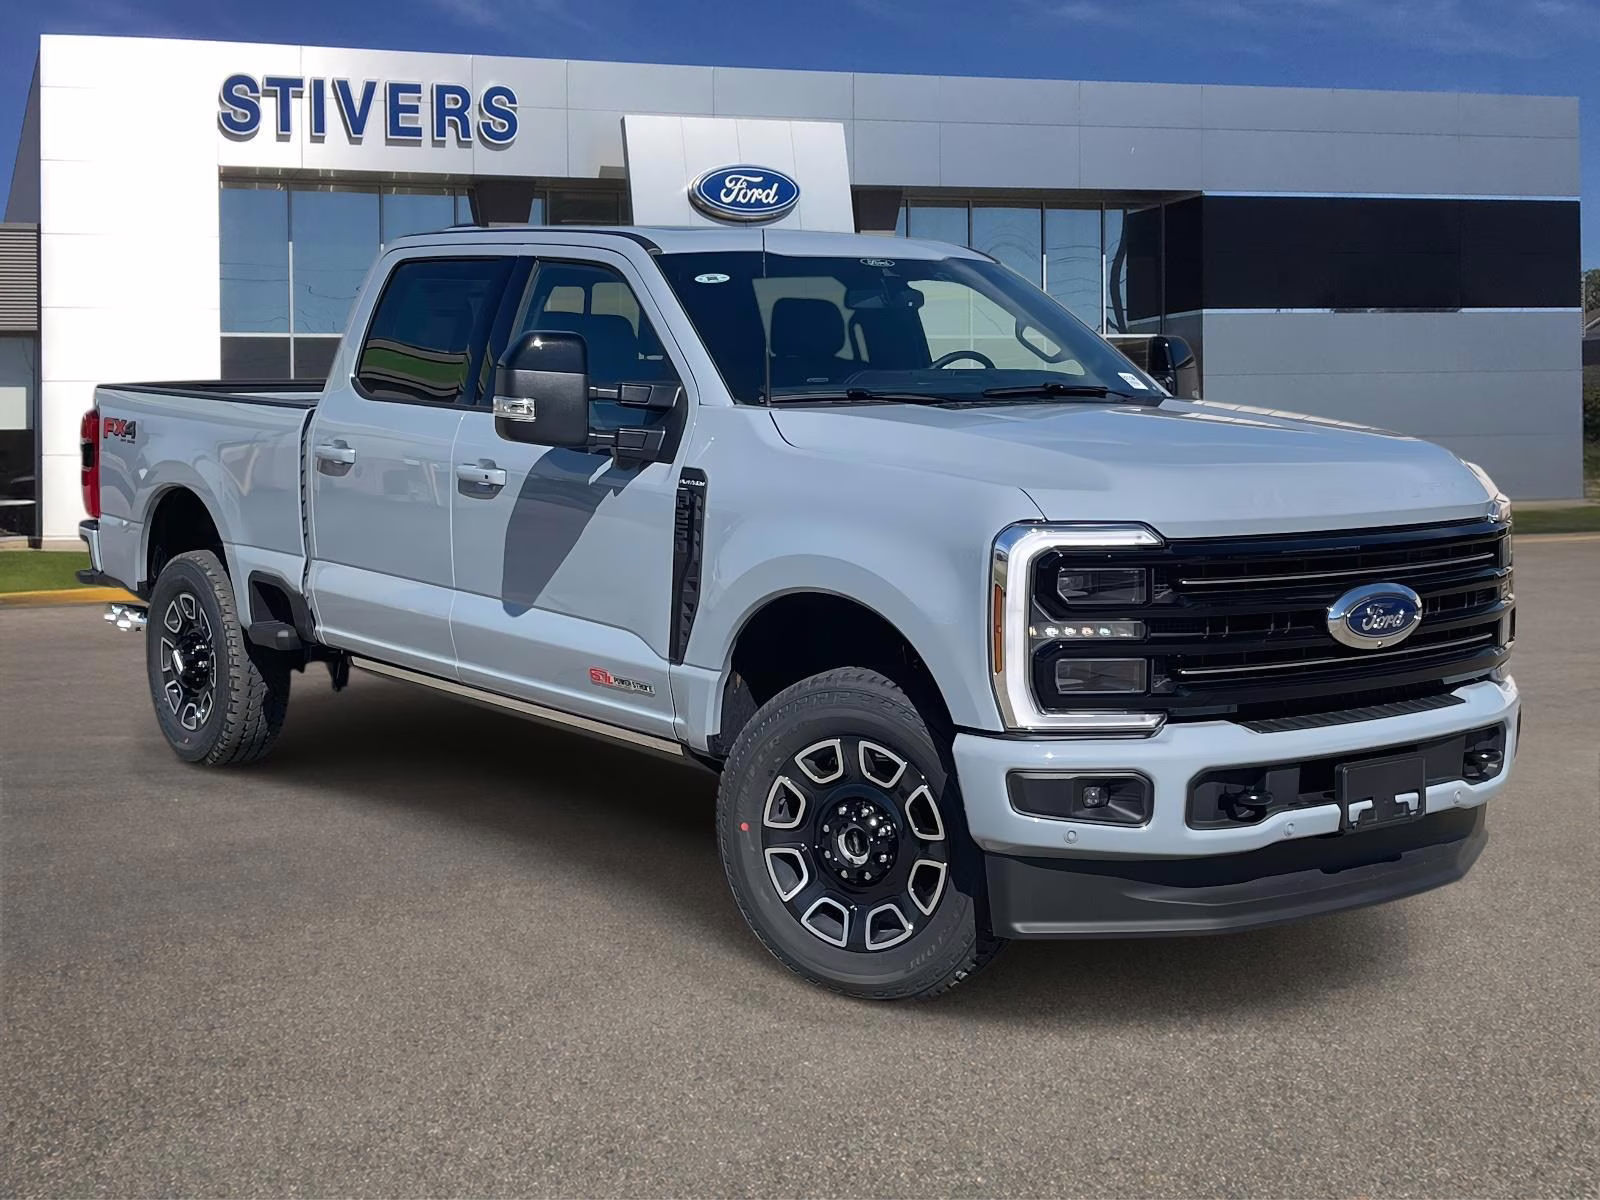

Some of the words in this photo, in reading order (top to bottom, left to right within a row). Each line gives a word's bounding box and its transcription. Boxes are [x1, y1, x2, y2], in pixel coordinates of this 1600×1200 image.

[217, 73, 519, 144] STIVERS
[720, 174, 779, 204] Ford
[103, 416, 136, 439] FX4
[1361, 603, 1405, 631] Ford
